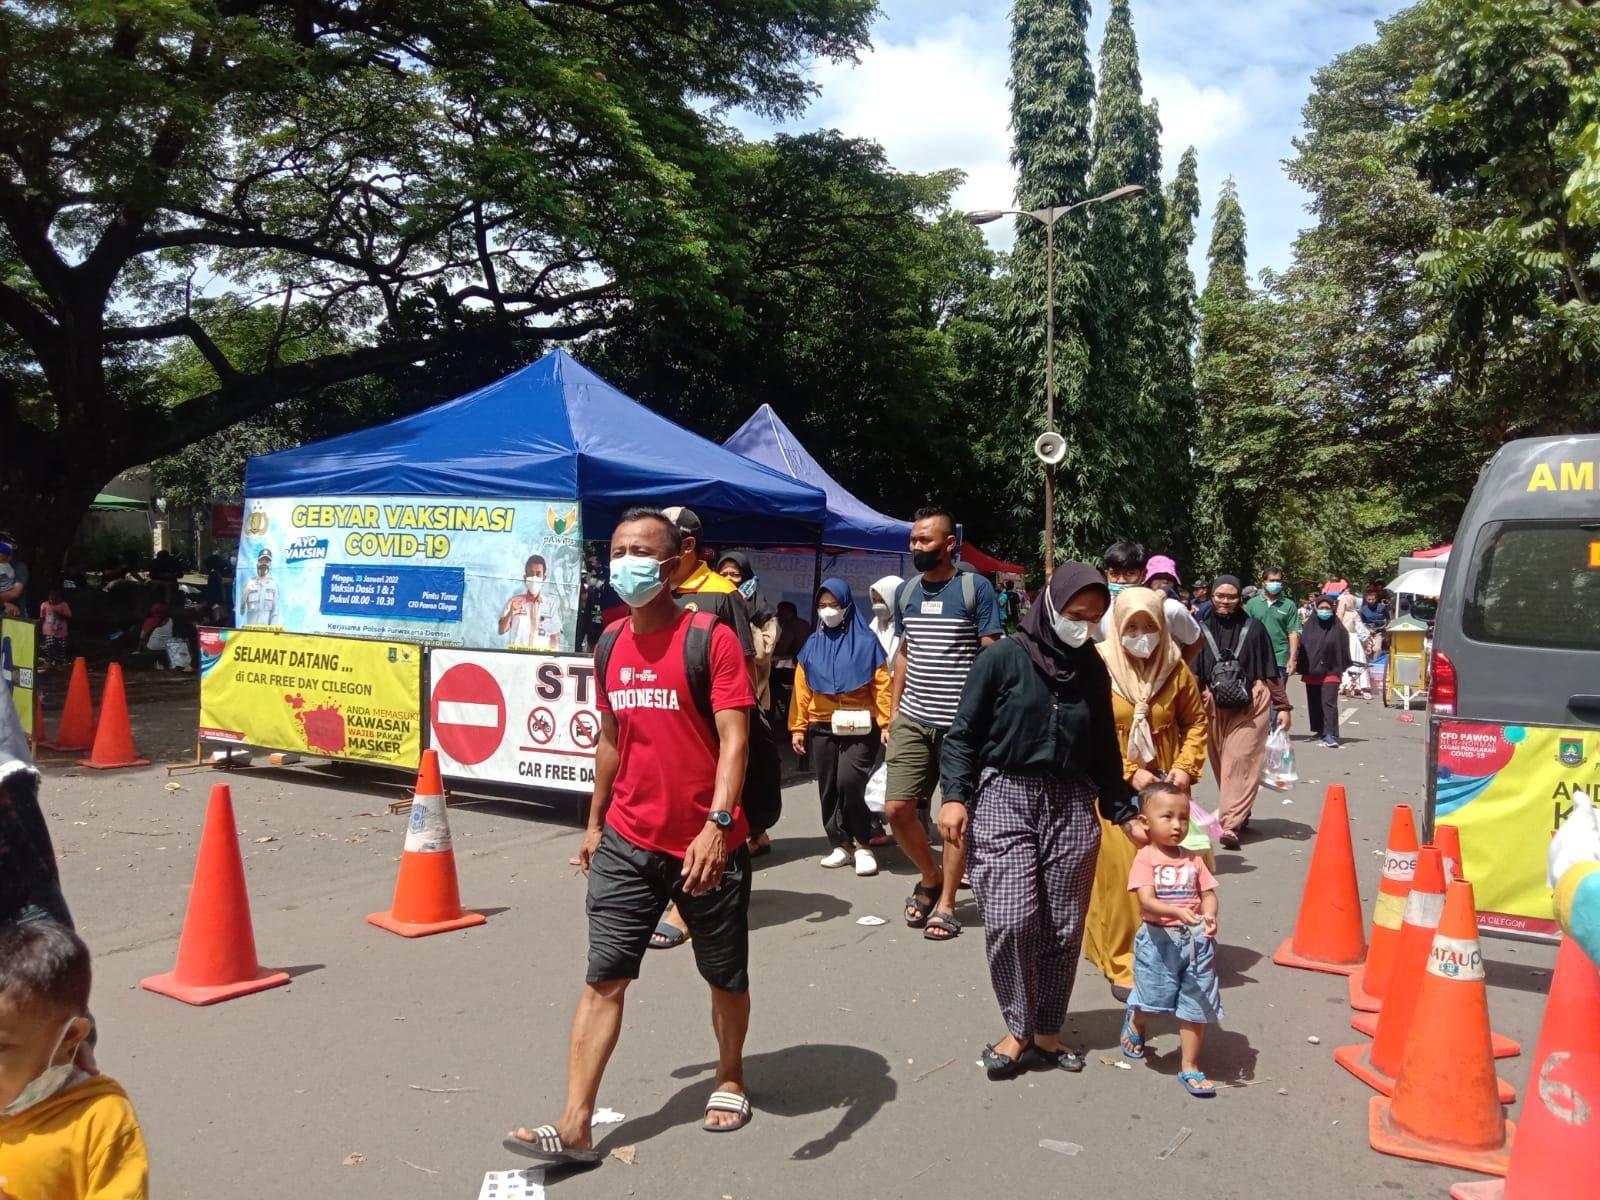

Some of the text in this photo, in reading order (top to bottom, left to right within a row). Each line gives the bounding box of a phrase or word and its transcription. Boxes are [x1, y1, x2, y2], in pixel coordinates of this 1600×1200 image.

[1526, 461, 1600, 493] AM
[292, 505, 515, 532] GEBYAR VAKSINASI
[295, 535, 318, 548] AYO
[345, 532, 450, 559] COVID-19
[285, 546, 327, 560] VAKSIN
[385, 576, 399, 584] 2022
[331, 583, 355, 593] Vaksin
[355, 584, 376, 594] Dosis
[381, 585, 389, 595] &
[389, 585, 395, 595] 2
[329, 594, 350, 604] Pukul
[350, 595, 370, 605] 08.00
[376, 596, 395, 607] 10.30
[327, 623, 361, 633] Kerjasama
[233, 646, 287, 666] SELAMAT
[288, 650, 339, 672] DATANG
[235, 671, 372, 696] di CAR FREE DAY CILEGON
[346, 705, 371, 716] ANDA
[347, 715, 410, 733] KAWASAN
[348, 728, 403, 741] WAJIB PAKAI
[1440, 732, 1497, 743] CFD PAWON
[348, 737, 401, 754] MASKER
[1450, 750, 1486, 759] COVID-19
[518, 761, 542, 776] CAR
[545, 764, 576, 781] FREE
[1488, 916, 1526, 928] CILEGON
